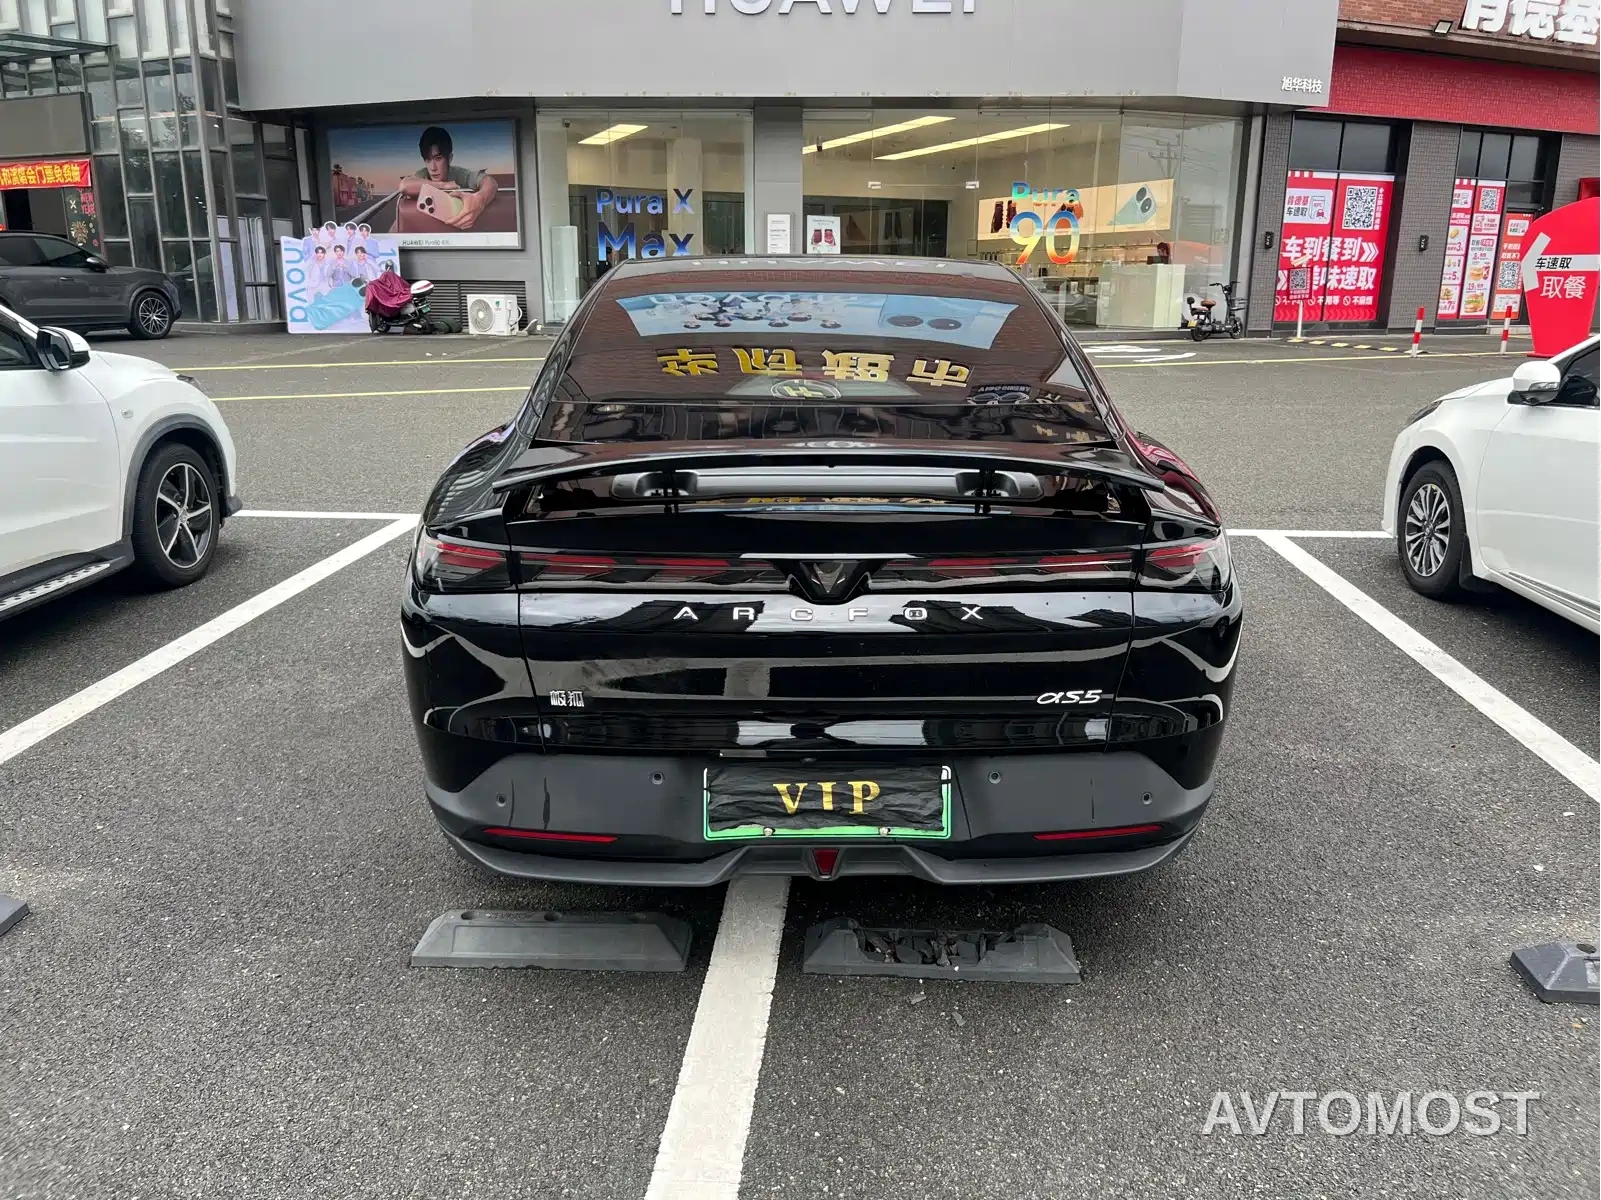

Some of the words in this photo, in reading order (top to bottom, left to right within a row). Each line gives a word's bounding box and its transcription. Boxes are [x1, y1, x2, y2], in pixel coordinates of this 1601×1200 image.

[1281, 76, 1323, 93] 旭华科技
[597, 189, 663, 214] Pura
[672, 188, 695, 214] X
[1011, 181, 1080, 206] Pura
[597, 221, 695, 261] Max
[1010, 211, 1080, 265] 90
[1281, 236, 1362, 262] 车到餐到
[1535, 257, 1572, 269] 车速取
[284, 247, 309, 323] nova
[1540, 275, 1586, 299] 取餐
[673, 606, 984, 621] ARCFOX
[772, 780, 881, 815] VIP
